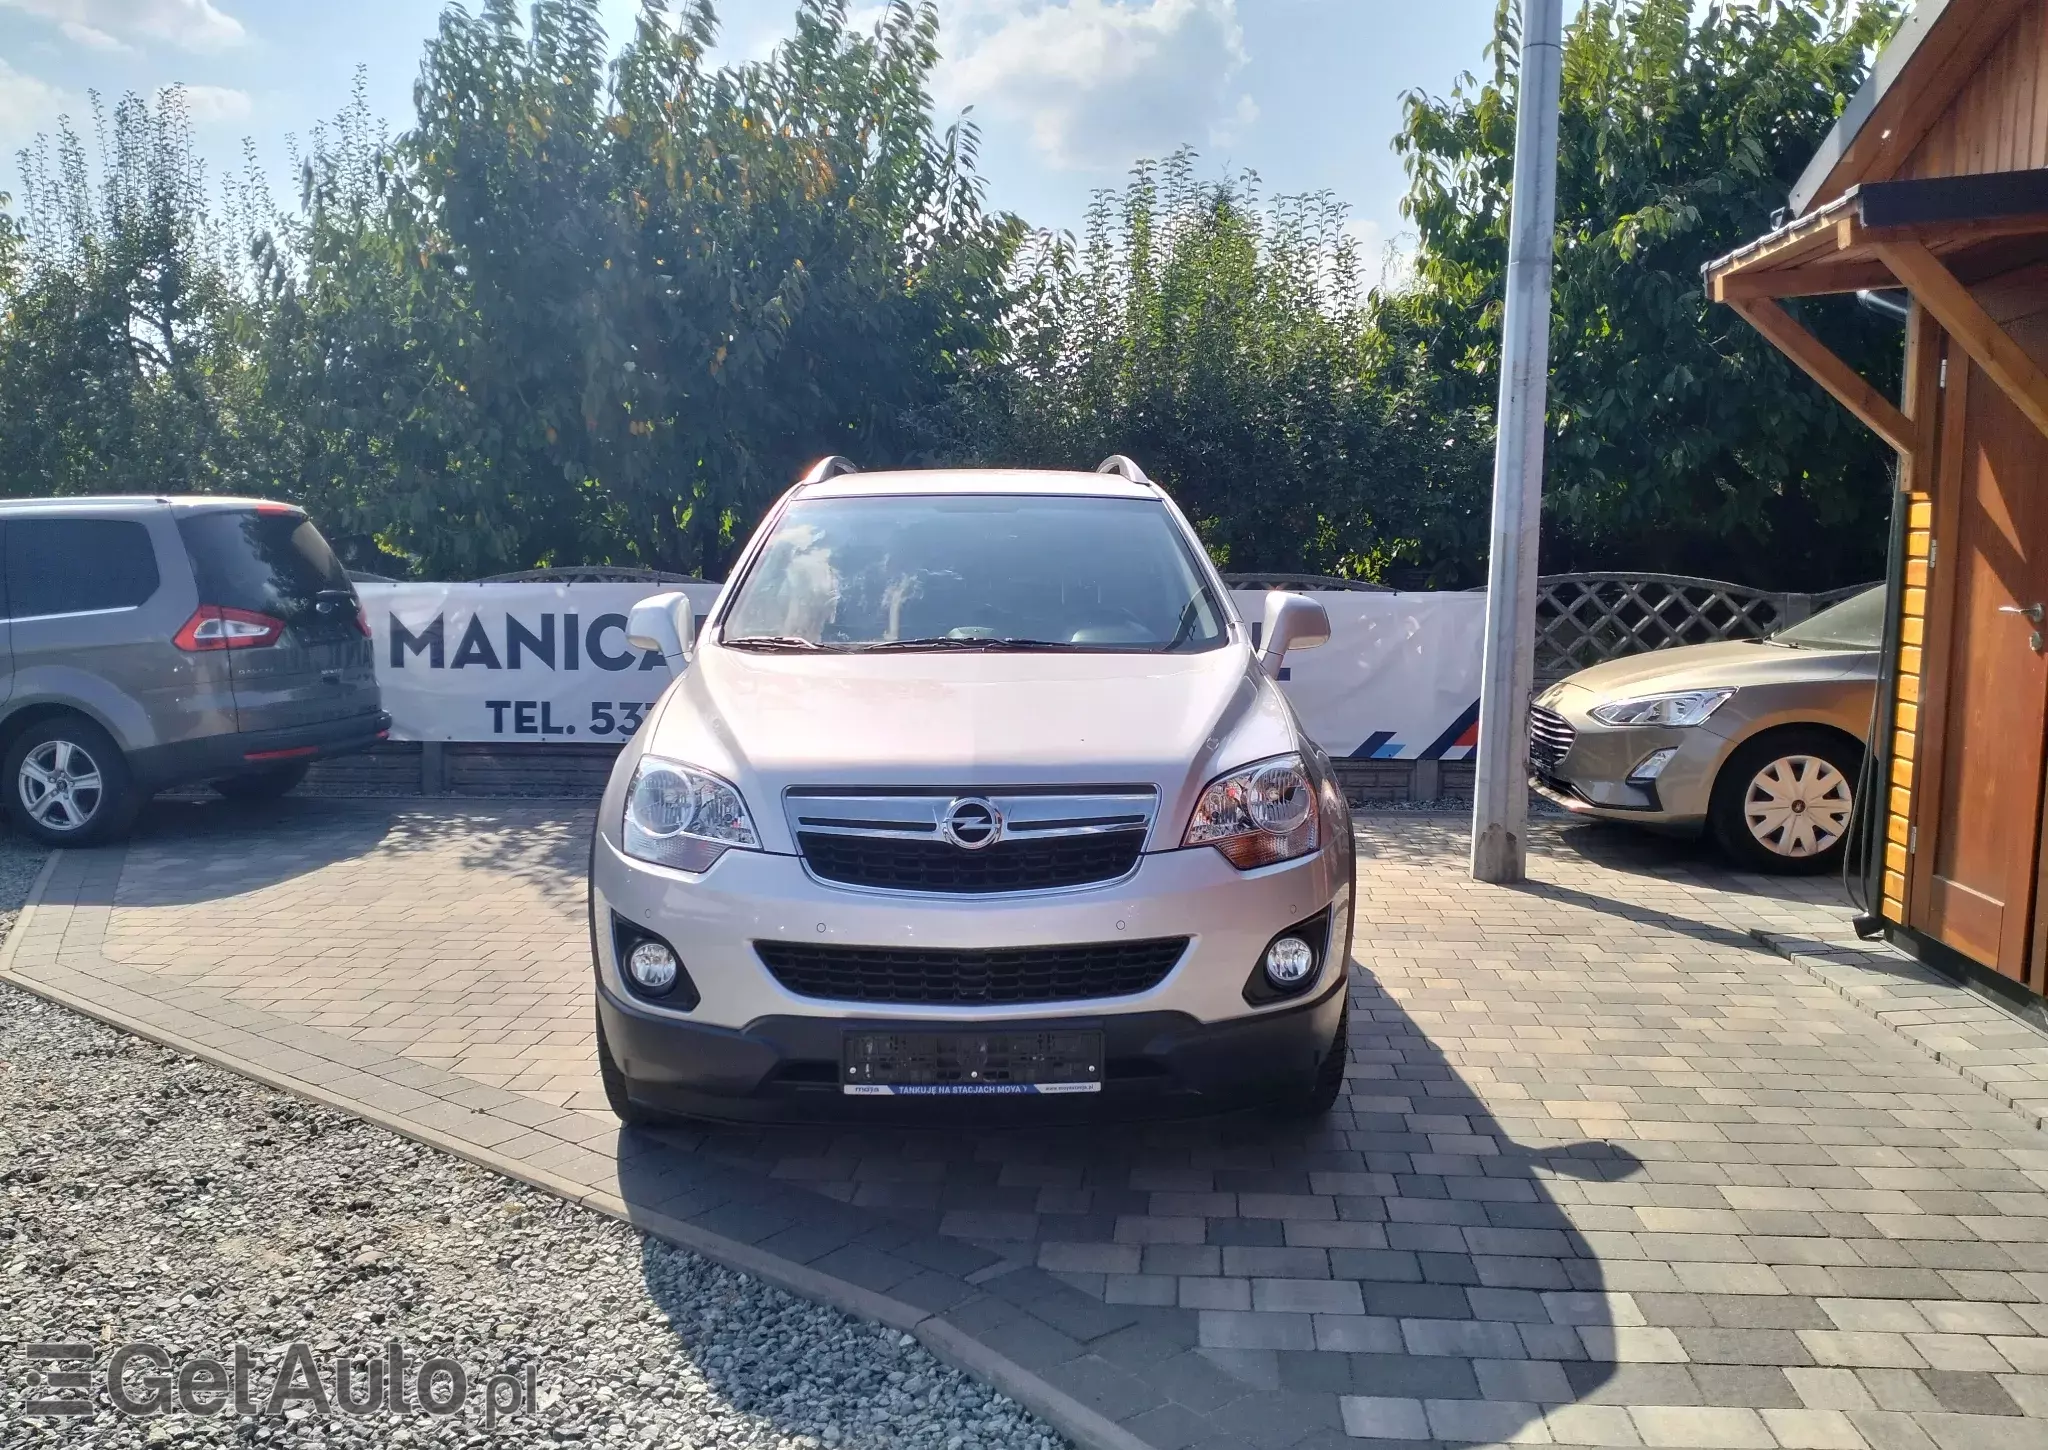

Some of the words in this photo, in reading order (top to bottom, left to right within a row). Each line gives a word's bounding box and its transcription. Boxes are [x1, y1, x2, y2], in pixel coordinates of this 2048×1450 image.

[389, 611, 708, 671] MANIC
[485, 700, 576, 735] TEL.
[588, 702, 656, 736] 53
[899, 1085, 937, 1096] TANKUJĘ
[938, 1085, 951, 1094] NA
[952, 1085, 995, 1094] STACJACH
[997, 1084, 1021, 1094] MOYA
